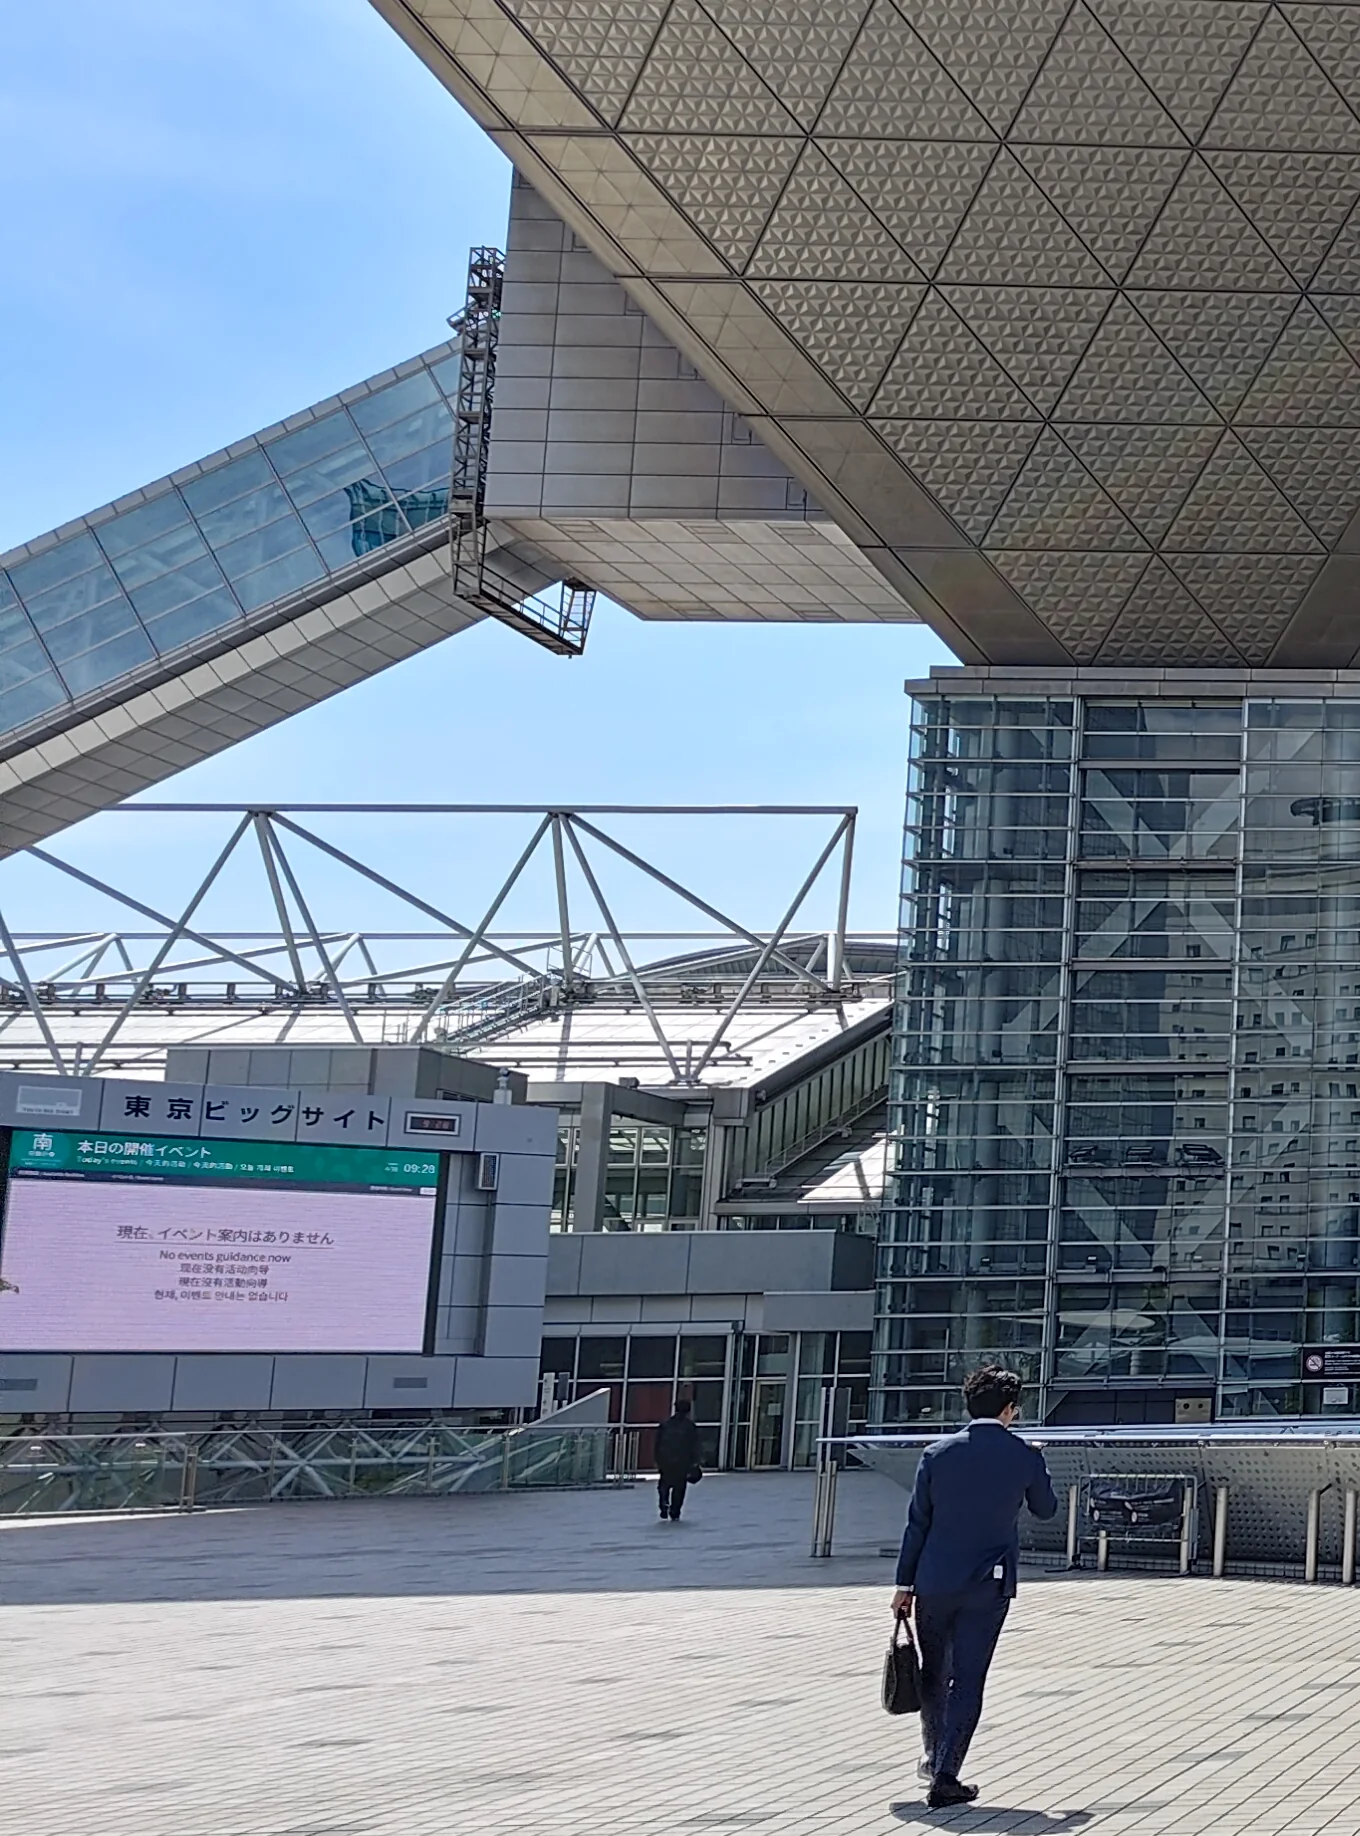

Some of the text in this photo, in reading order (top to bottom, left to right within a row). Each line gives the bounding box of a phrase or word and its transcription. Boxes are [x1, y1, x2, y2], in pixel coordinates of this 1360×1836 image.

[124, 1095, 385, 1130] 東京ビッグサイト
[77, 1140, 212, 1159] 本日の開催イベント
[116, 1225, 334, 1245] 現在、イベント案内はありません
[159, 1250, 292, 1263] No events guidance now
